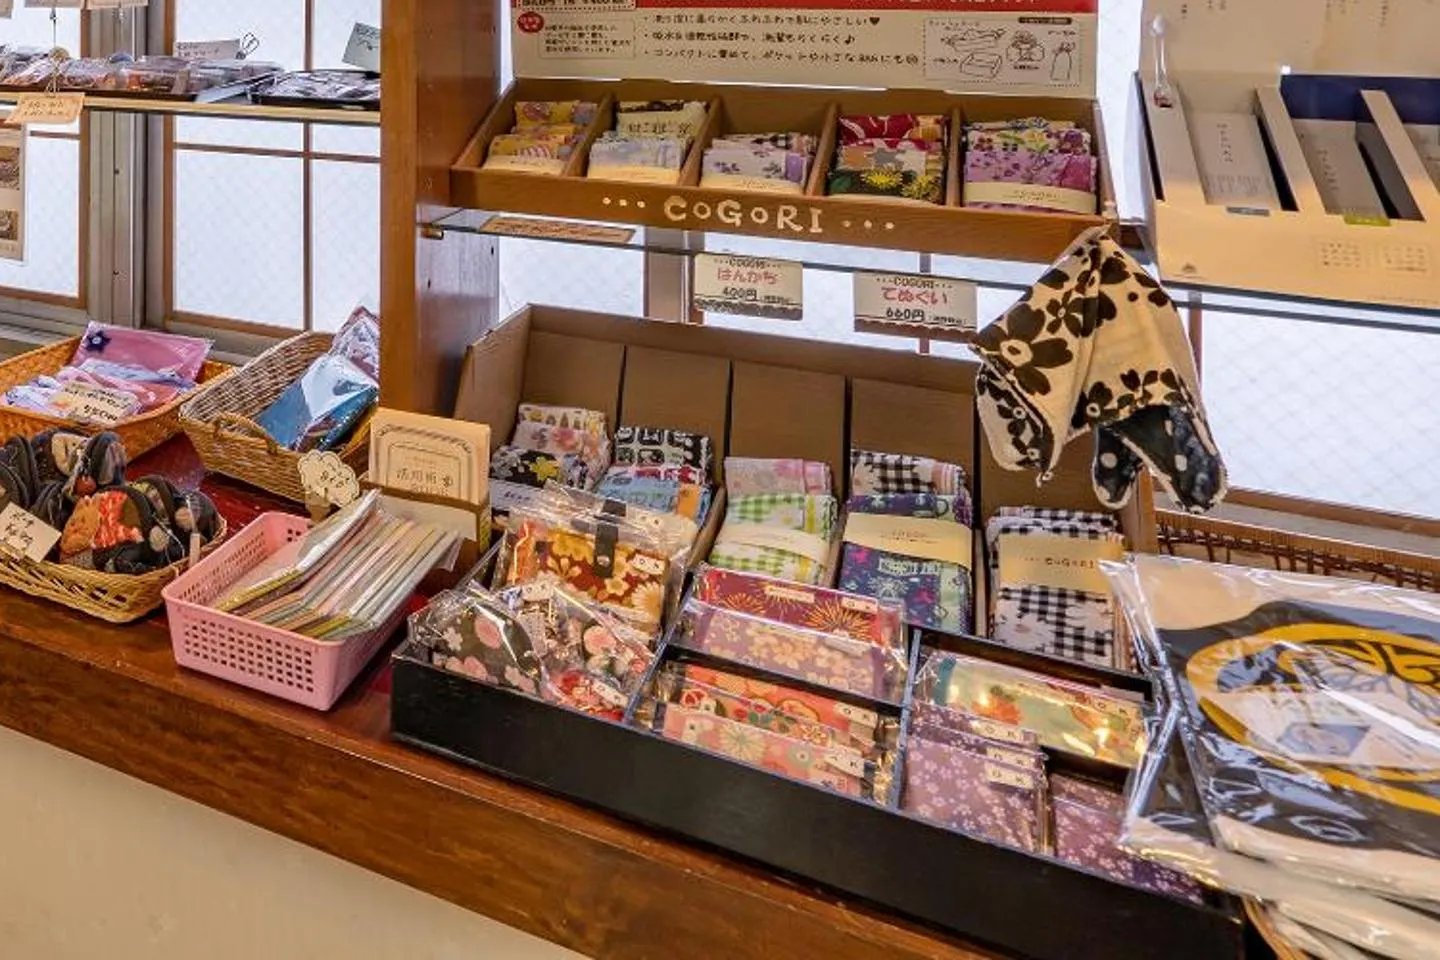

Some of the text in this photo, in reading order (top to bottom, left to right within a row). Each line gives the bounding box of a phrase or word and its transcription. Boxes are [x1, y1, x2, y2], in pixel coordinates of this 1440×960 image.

[717, 267, 778, 285] はんかち
[881, 287, 948, 305] てぬぐい
